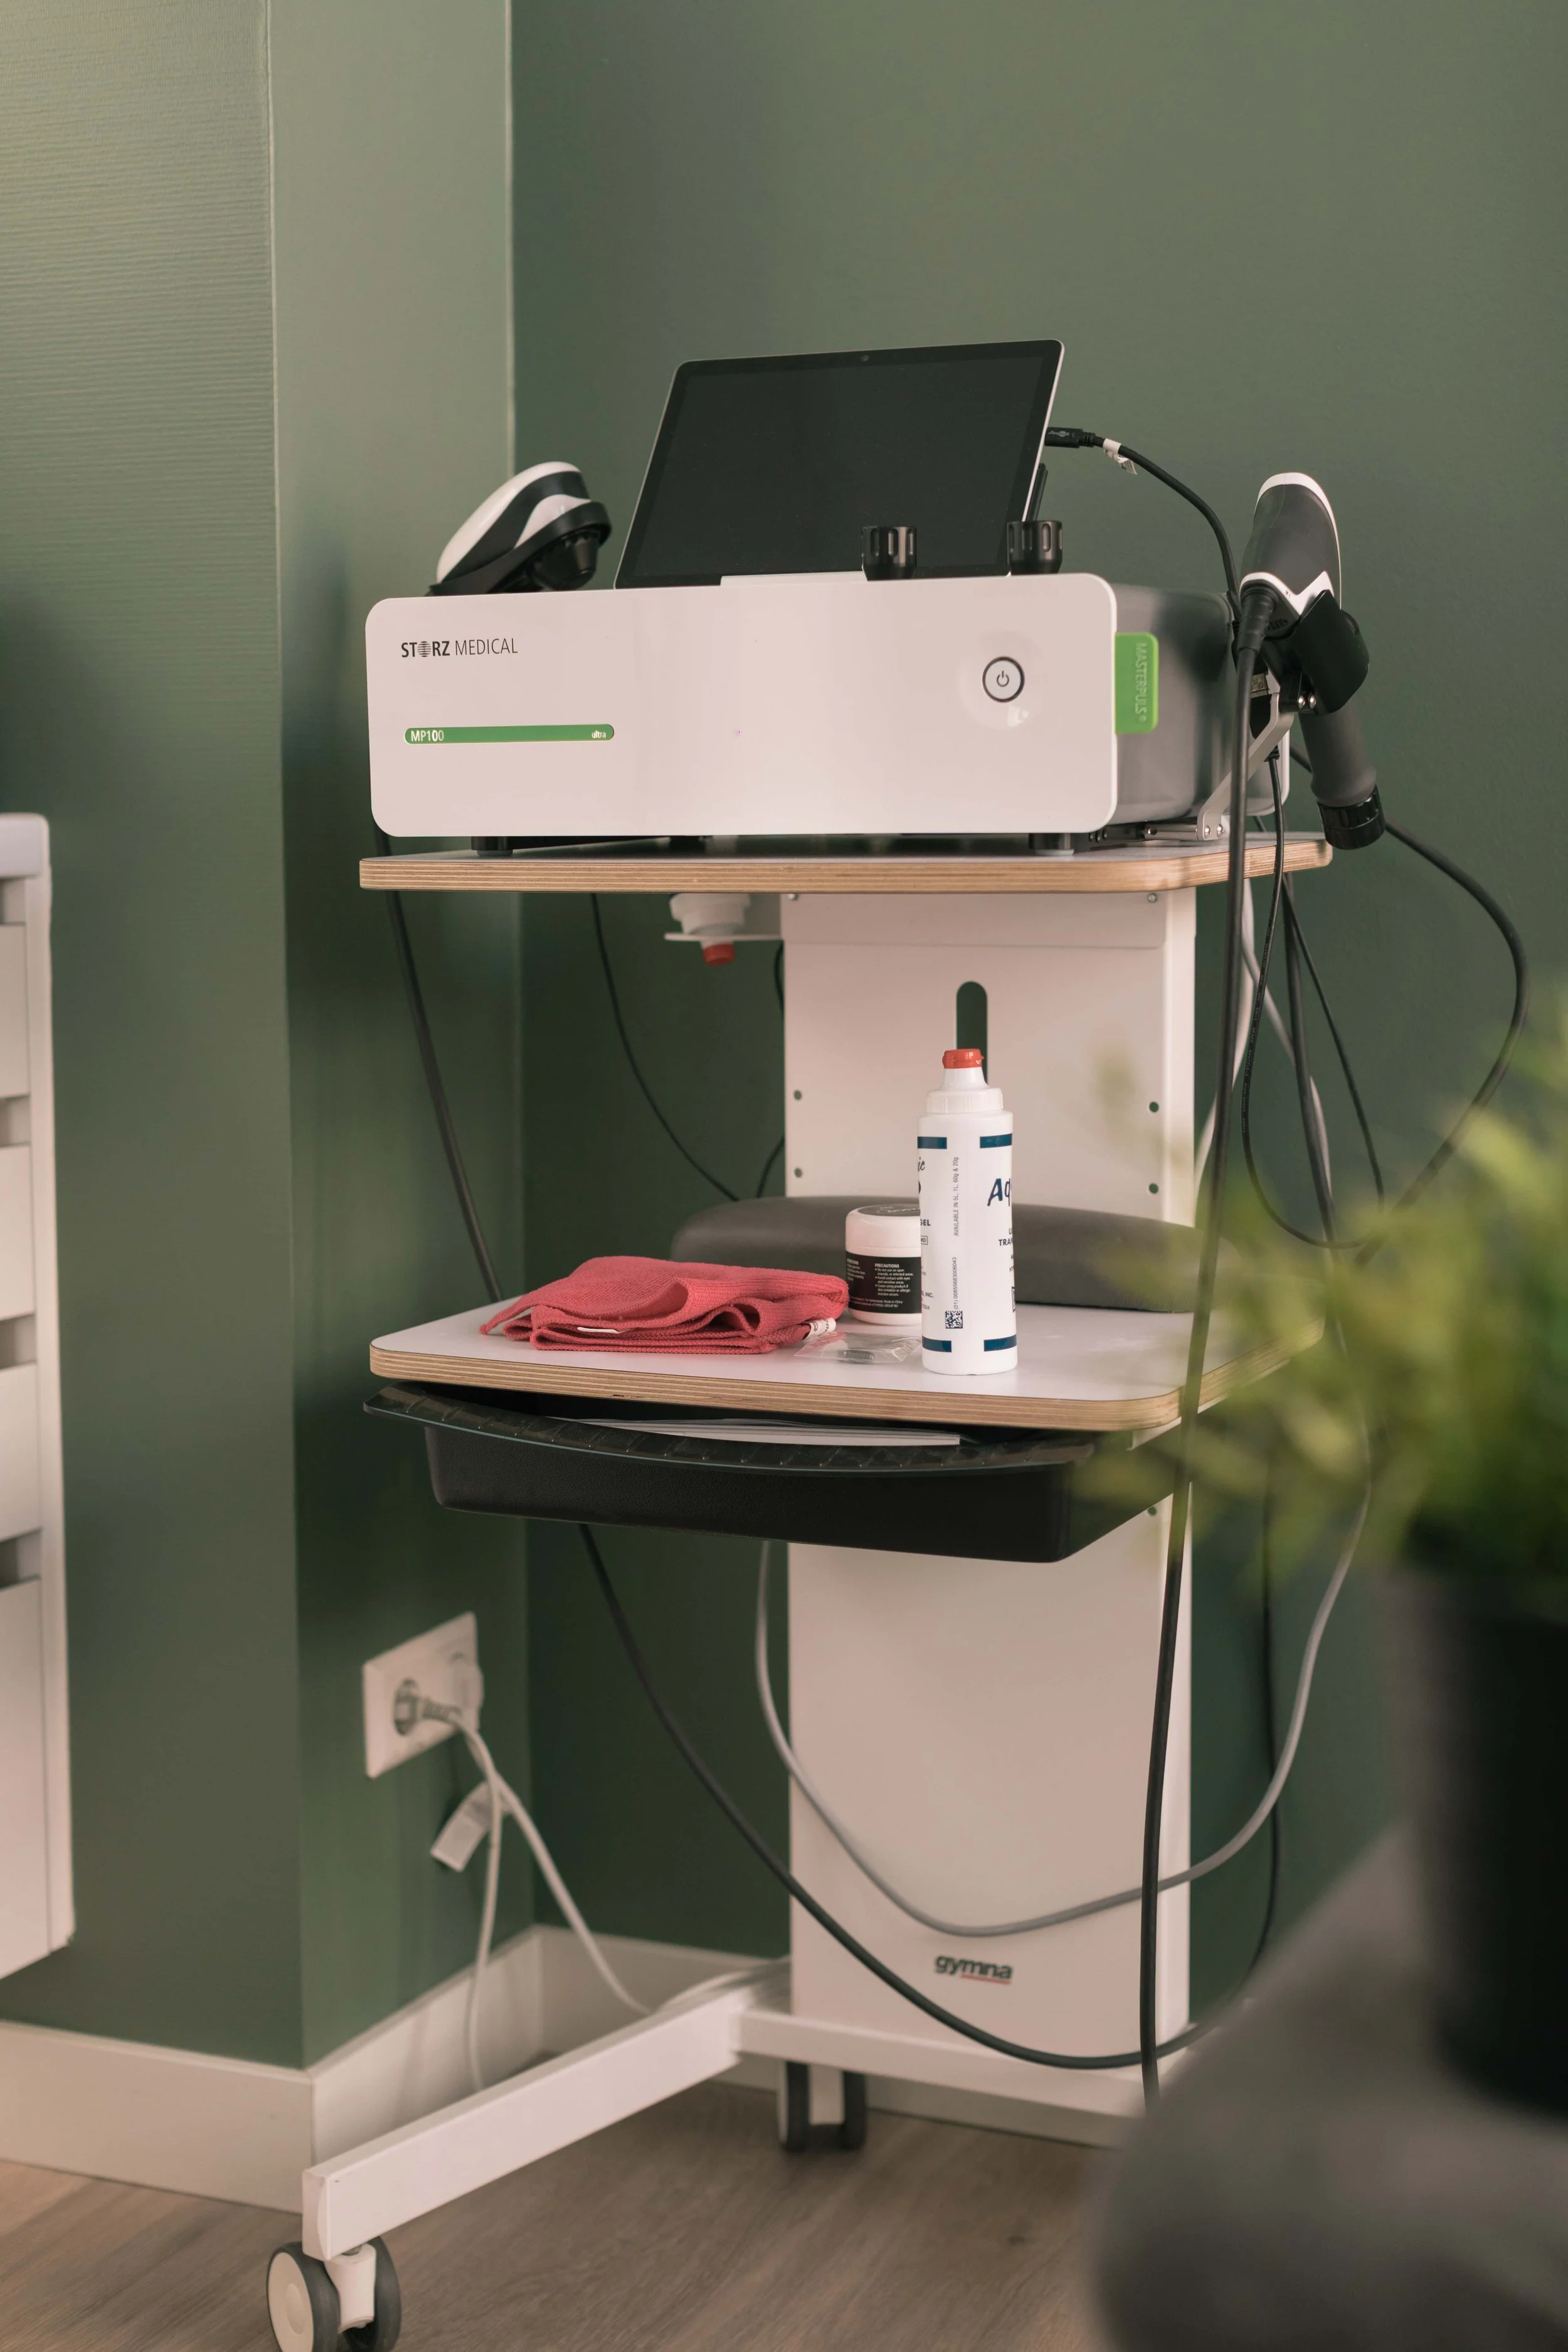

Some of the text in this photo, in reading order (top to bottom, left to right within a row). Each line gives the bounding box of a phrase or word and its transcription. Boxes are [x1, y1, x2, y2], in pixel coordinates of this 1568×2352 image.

[455, 637, 519, 656] MEDICAL
[410, 729, 607, 742] MP100 ultra
[935, 1955, 1014, 1979] gymna
